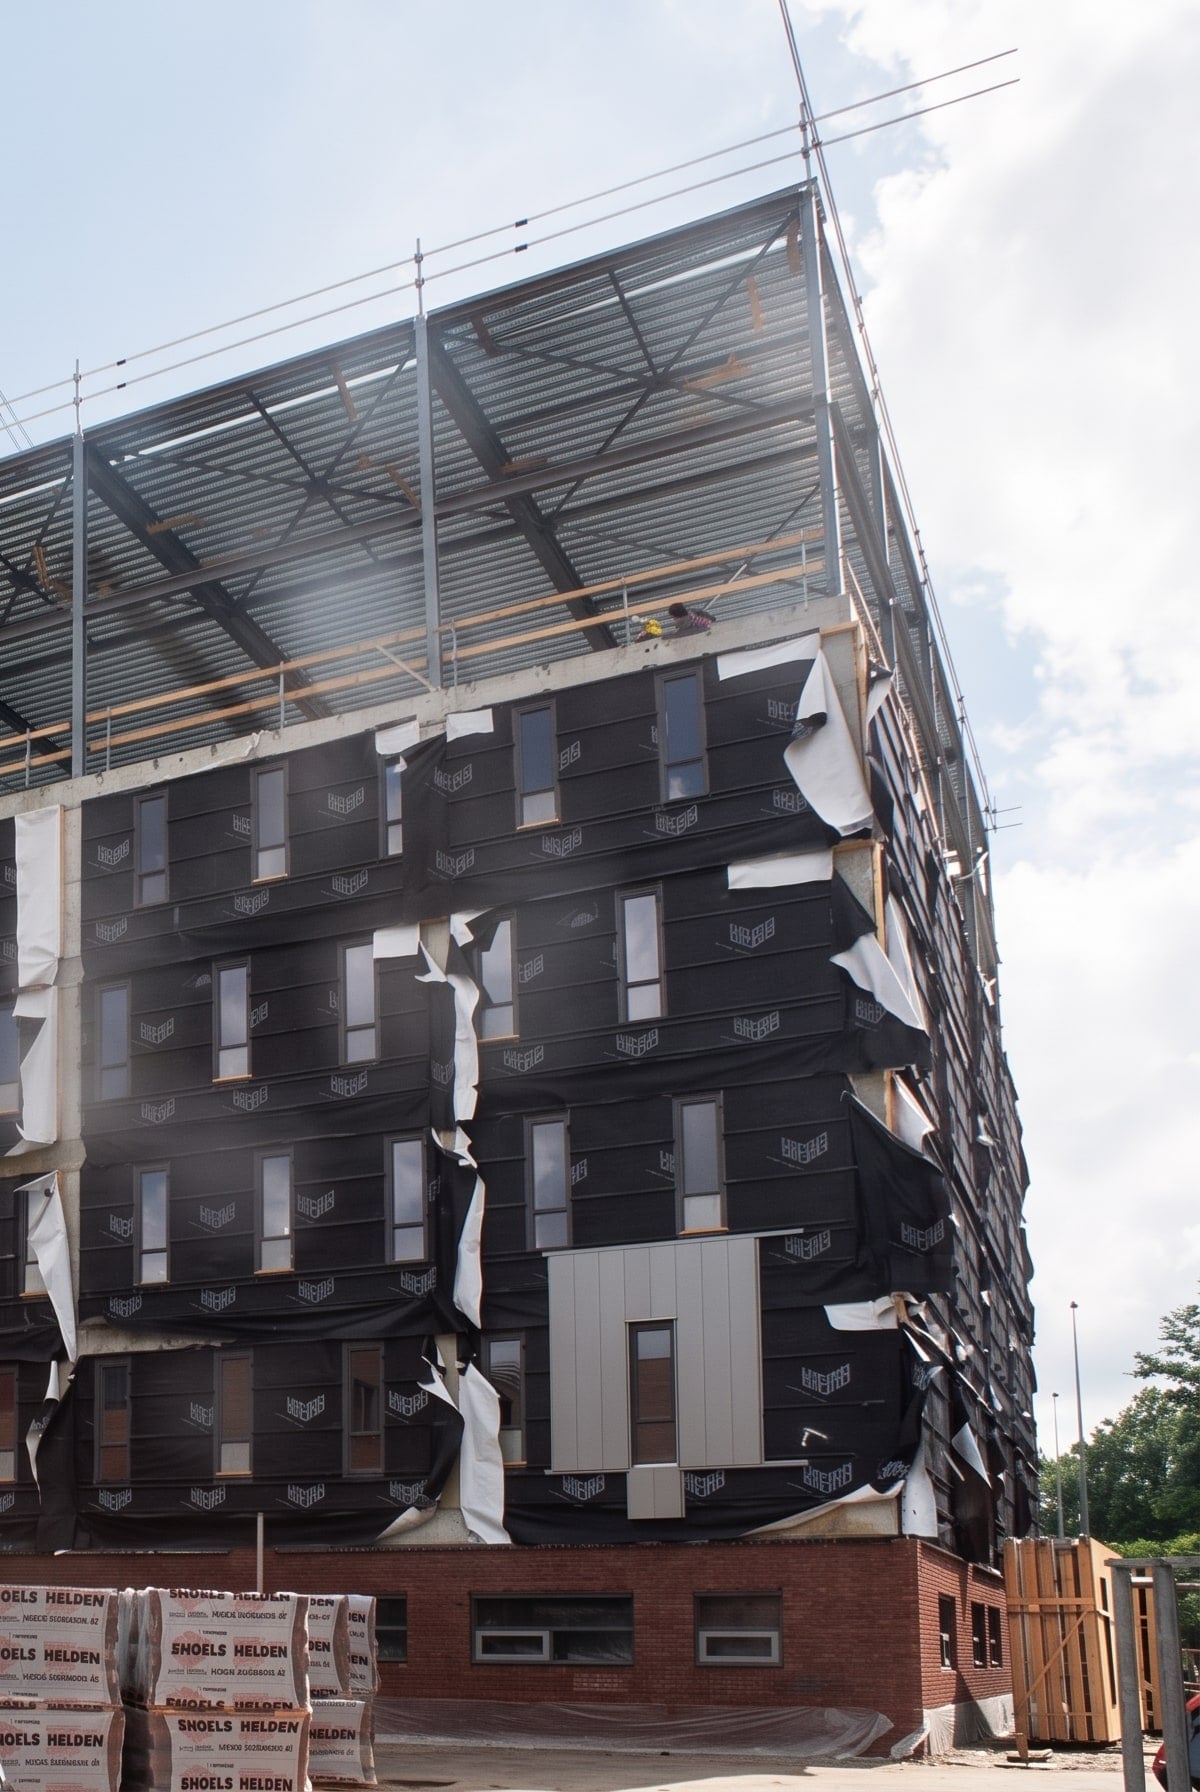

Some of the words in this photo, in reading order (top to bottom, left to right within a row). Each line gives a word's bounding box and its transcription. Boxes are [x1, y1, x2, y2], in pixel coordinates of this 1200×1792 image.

[46, 1591, 105, 1608] HELDEN
[349, 1612, 366, 1623] EN
[44, 1649, 101, 1665] HELDEN
[234, 1644, 288, 1658] HELDEN
[348, 1655, 368, 1666] EN
[240, 1720, 300, 1734] HELDEN
[47, 1734, 104, 1747] HELDEN
[240, 1777, 293, 1791] HELDEN
